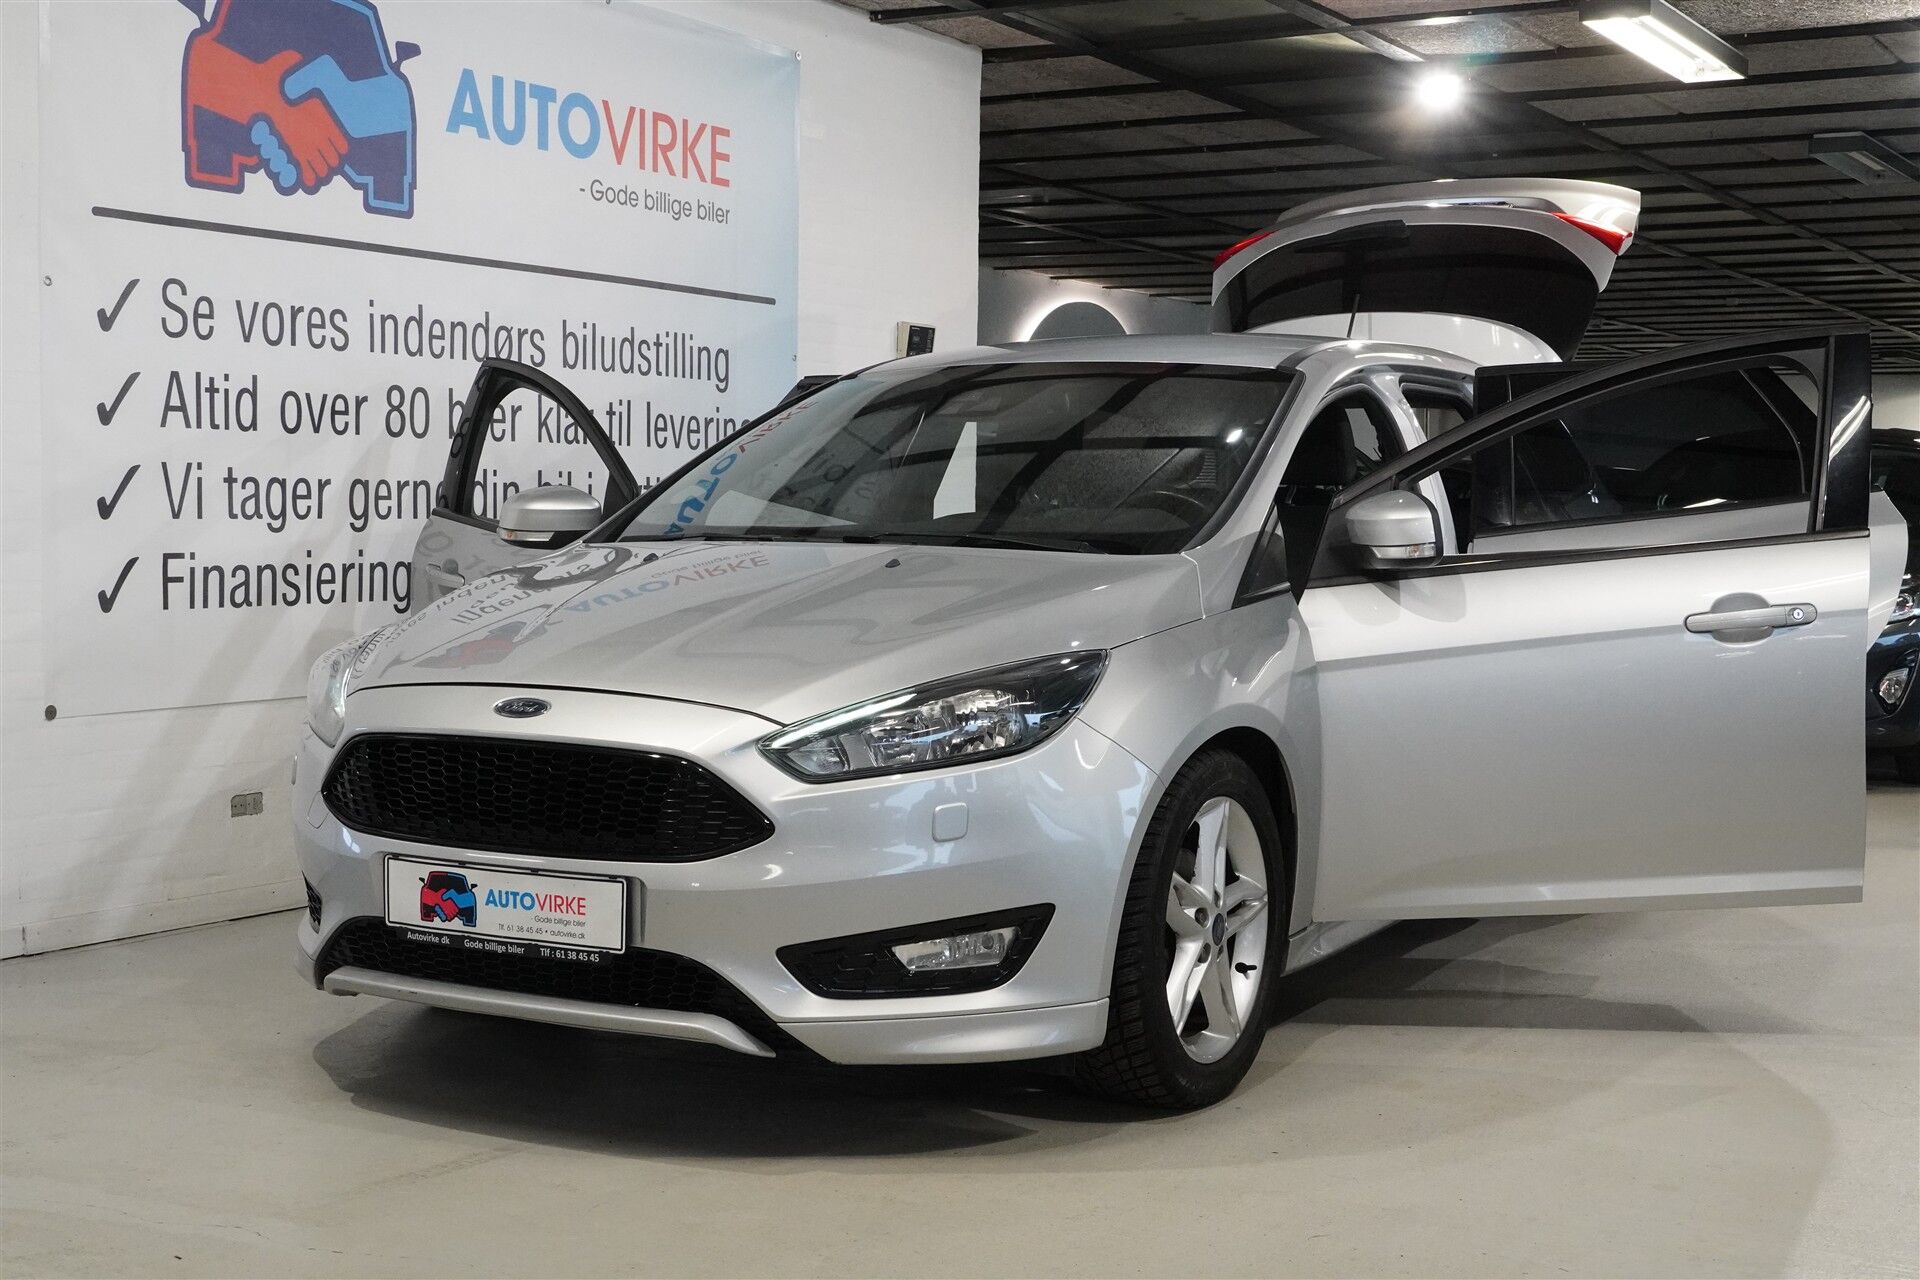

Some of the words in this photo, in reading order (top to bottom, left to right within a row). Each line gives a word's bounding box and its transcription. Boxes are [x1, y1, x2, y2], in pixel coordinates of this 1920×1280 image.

[445, 69, 731, 188] AUTOVIRKE
[590, 178, 638, 208] Gode
[645, 188, 693, 221] billige
[697, 198, 730, 225] biler
[161, 278, 215, 341] Se
[235, 299, 350, 352] vores
[368, 299, 546, 368] indendørs
[562, 319, 730, 393] biludstilling
[160, 370, 258, 433] Altid
[280, 390, 369, 436] over
[385, 384, 430, 439] 80
[606, 399, 631, 447] til
[646, 401, 753, 451] leverin
[161, 461, 203, 520] Vi
[223, 466, 331, 533] tager
[162, 549, 412, 614] Finansiering
[484, 888, 587, 916] AUTOVIRKE
[507, 924, 514, 932] 61
[516, 925, 525, 933] 38
[526, 926, 534, 934] 45
[535, 927, 543, 935] 45
[534, 914, 553, 924] Gode
[407, 931, 440, 943] Autovirke
[464, 939, 483, 950] Gode
[484, 941, 507, 953] billige
[507, 944, 525, 955] biler
[556, 949, 566, 959] 61
[567, 950, 577, 960] 38
[578, 952, 588, 961] 45
[589, 953, 600, 962] 45
